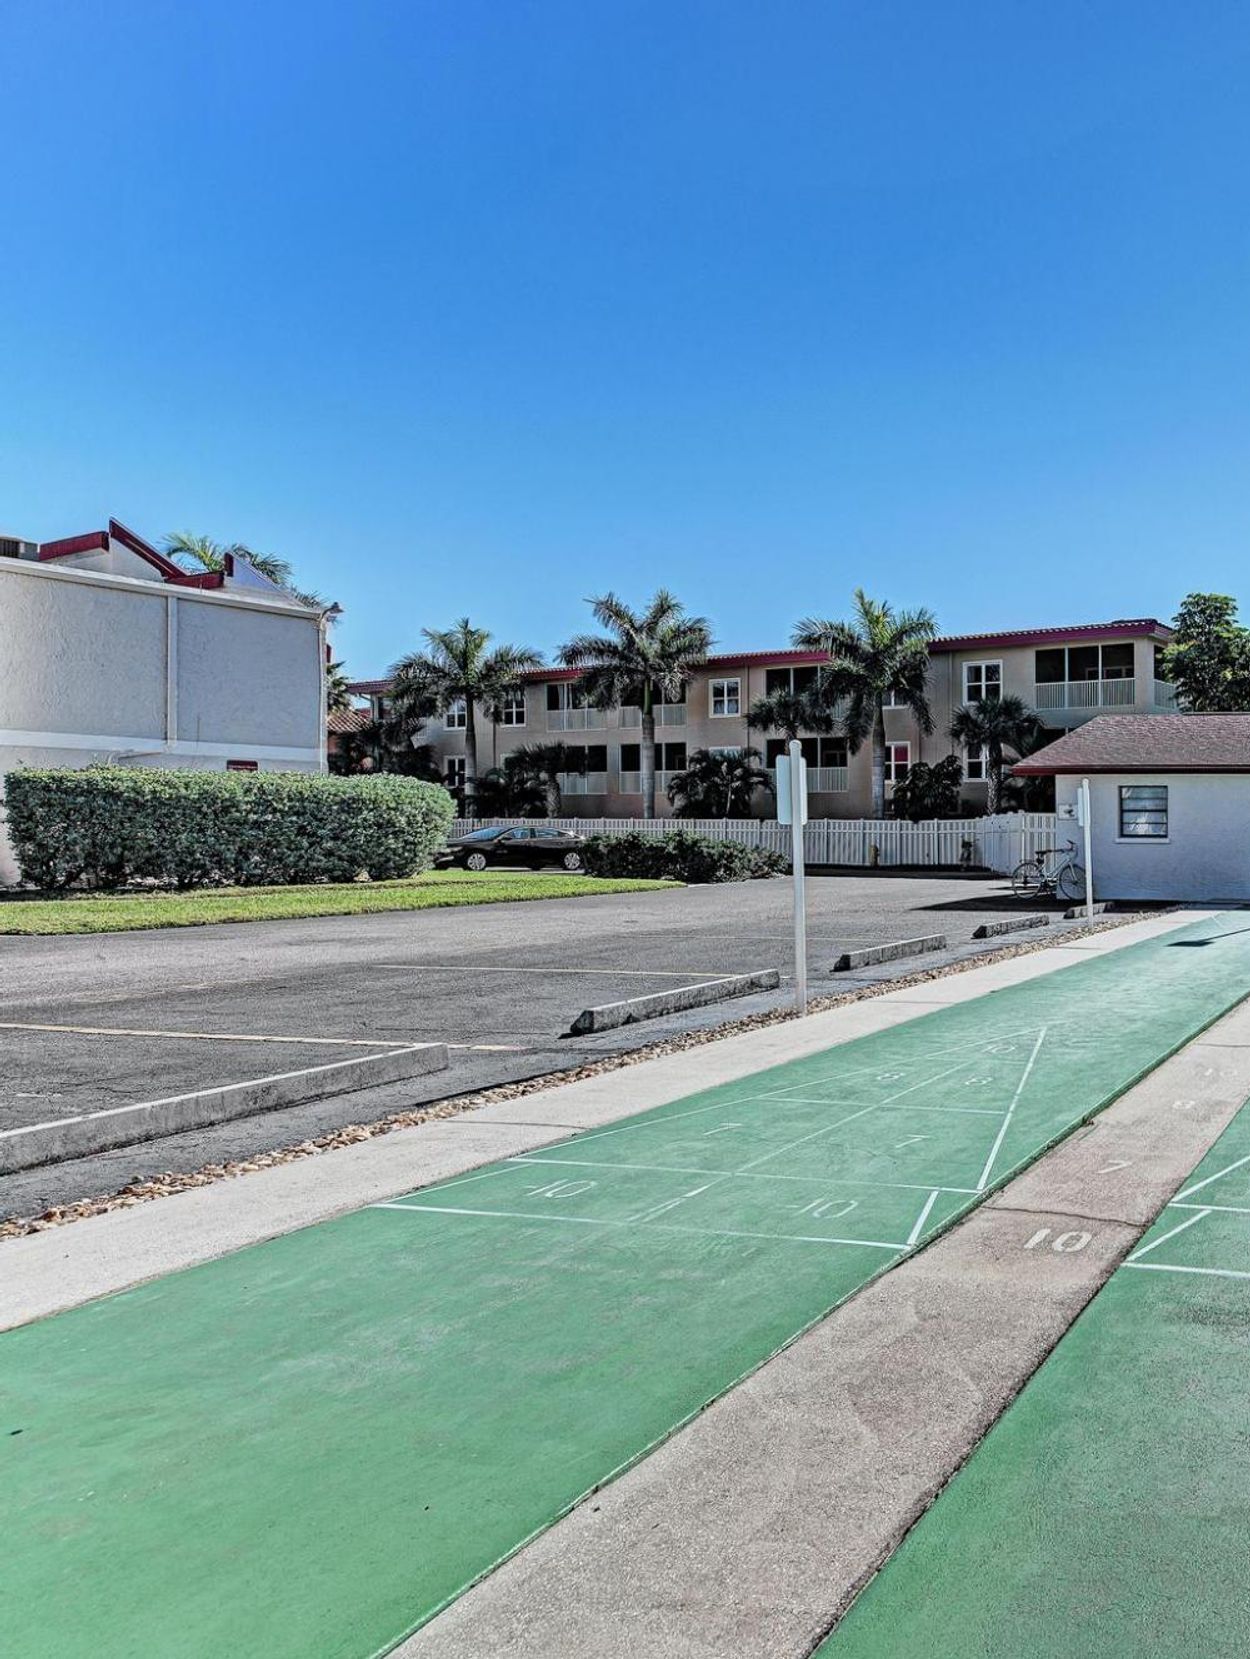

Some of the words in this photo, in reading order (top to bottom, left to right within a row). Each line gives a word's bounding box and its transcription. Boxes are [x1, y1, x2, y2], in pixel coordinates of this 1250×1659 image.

[703, 1122, 743, 1136] 7
[895, 1134, 931, 1149] 7
[1099, 1158, 1133, 1175] 7
[1023, 1227, 1094, 1254] 10
